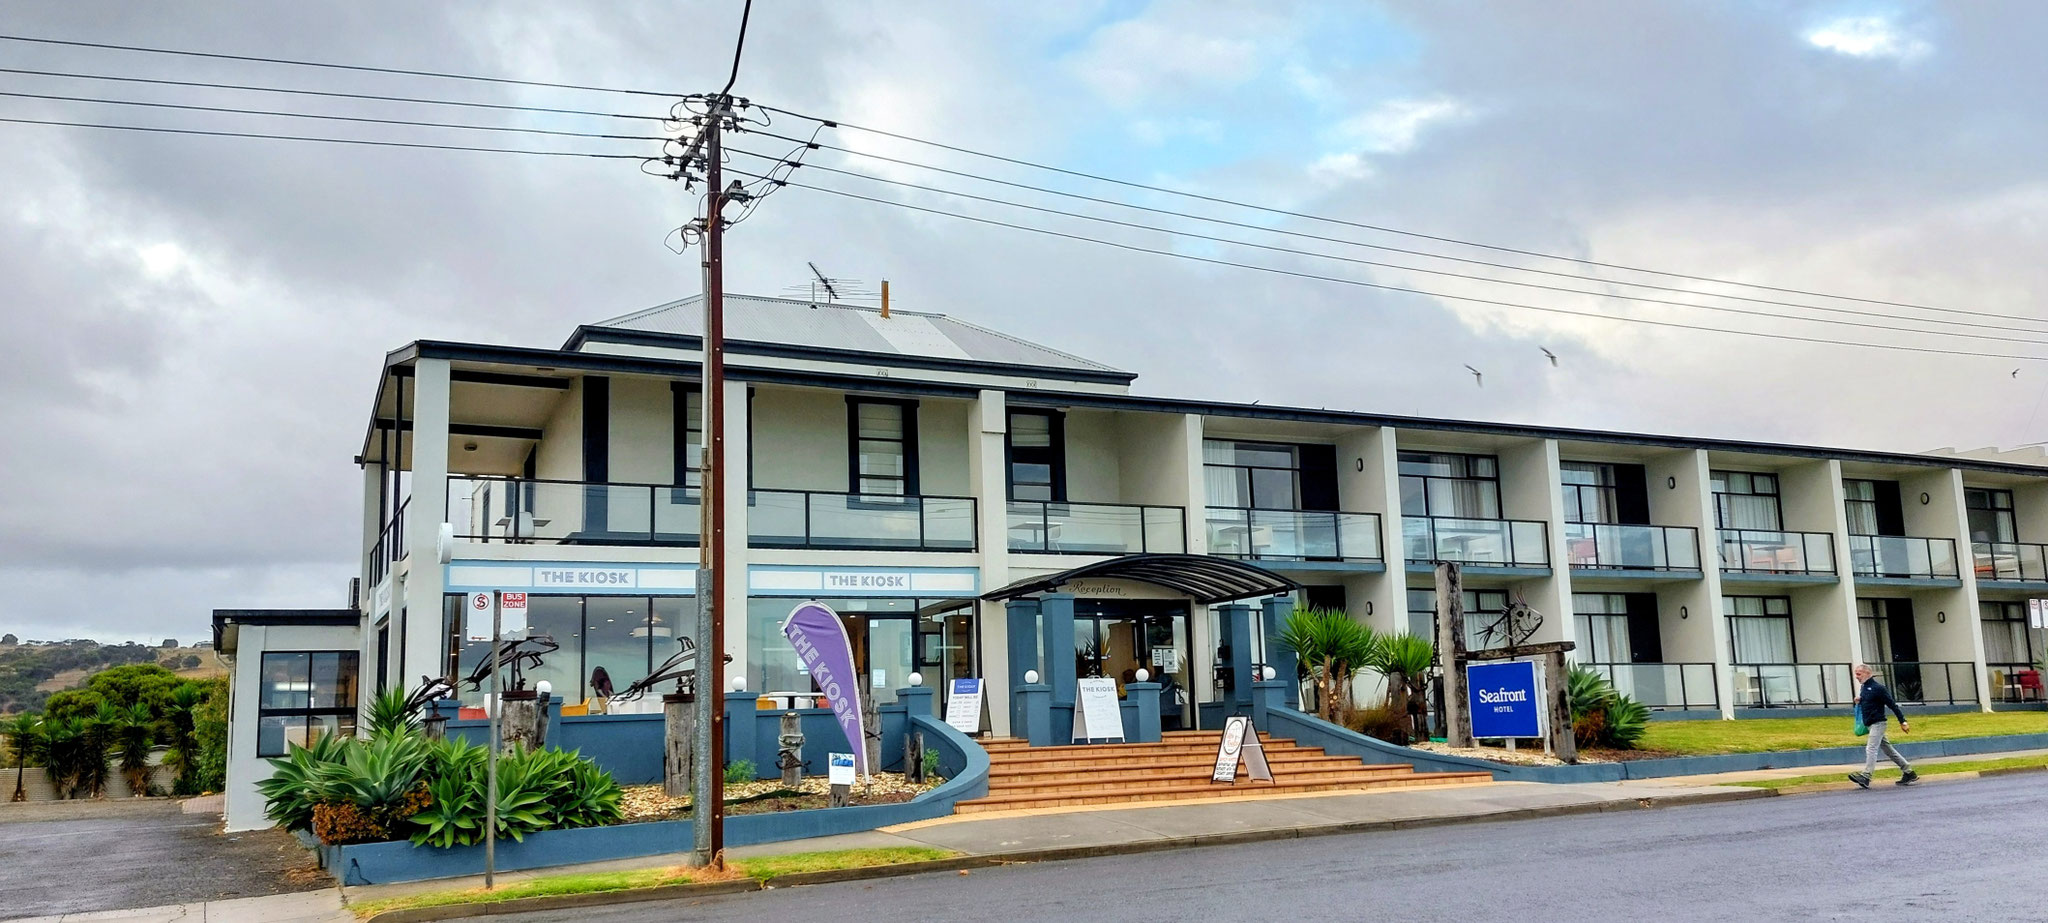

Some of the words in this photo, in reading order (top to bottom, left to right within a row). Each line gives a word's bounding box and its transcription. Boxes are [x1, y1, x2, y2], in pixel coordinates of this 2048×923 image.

[541, 571, 574, 583] THE
[578, 571, 629, 584] KIOSK
[829, 575, 857, 586] THE
[861, 575, 903, 587] KIOSK
[1069, 581, 1126, 596] Reception
[789, 623, 819, 664] THE
[814, 661, 857, 729] KIOSK
[1479, 687, 1527, 703] Seafront
[1493, 705, 1514, 713] HOTEL
